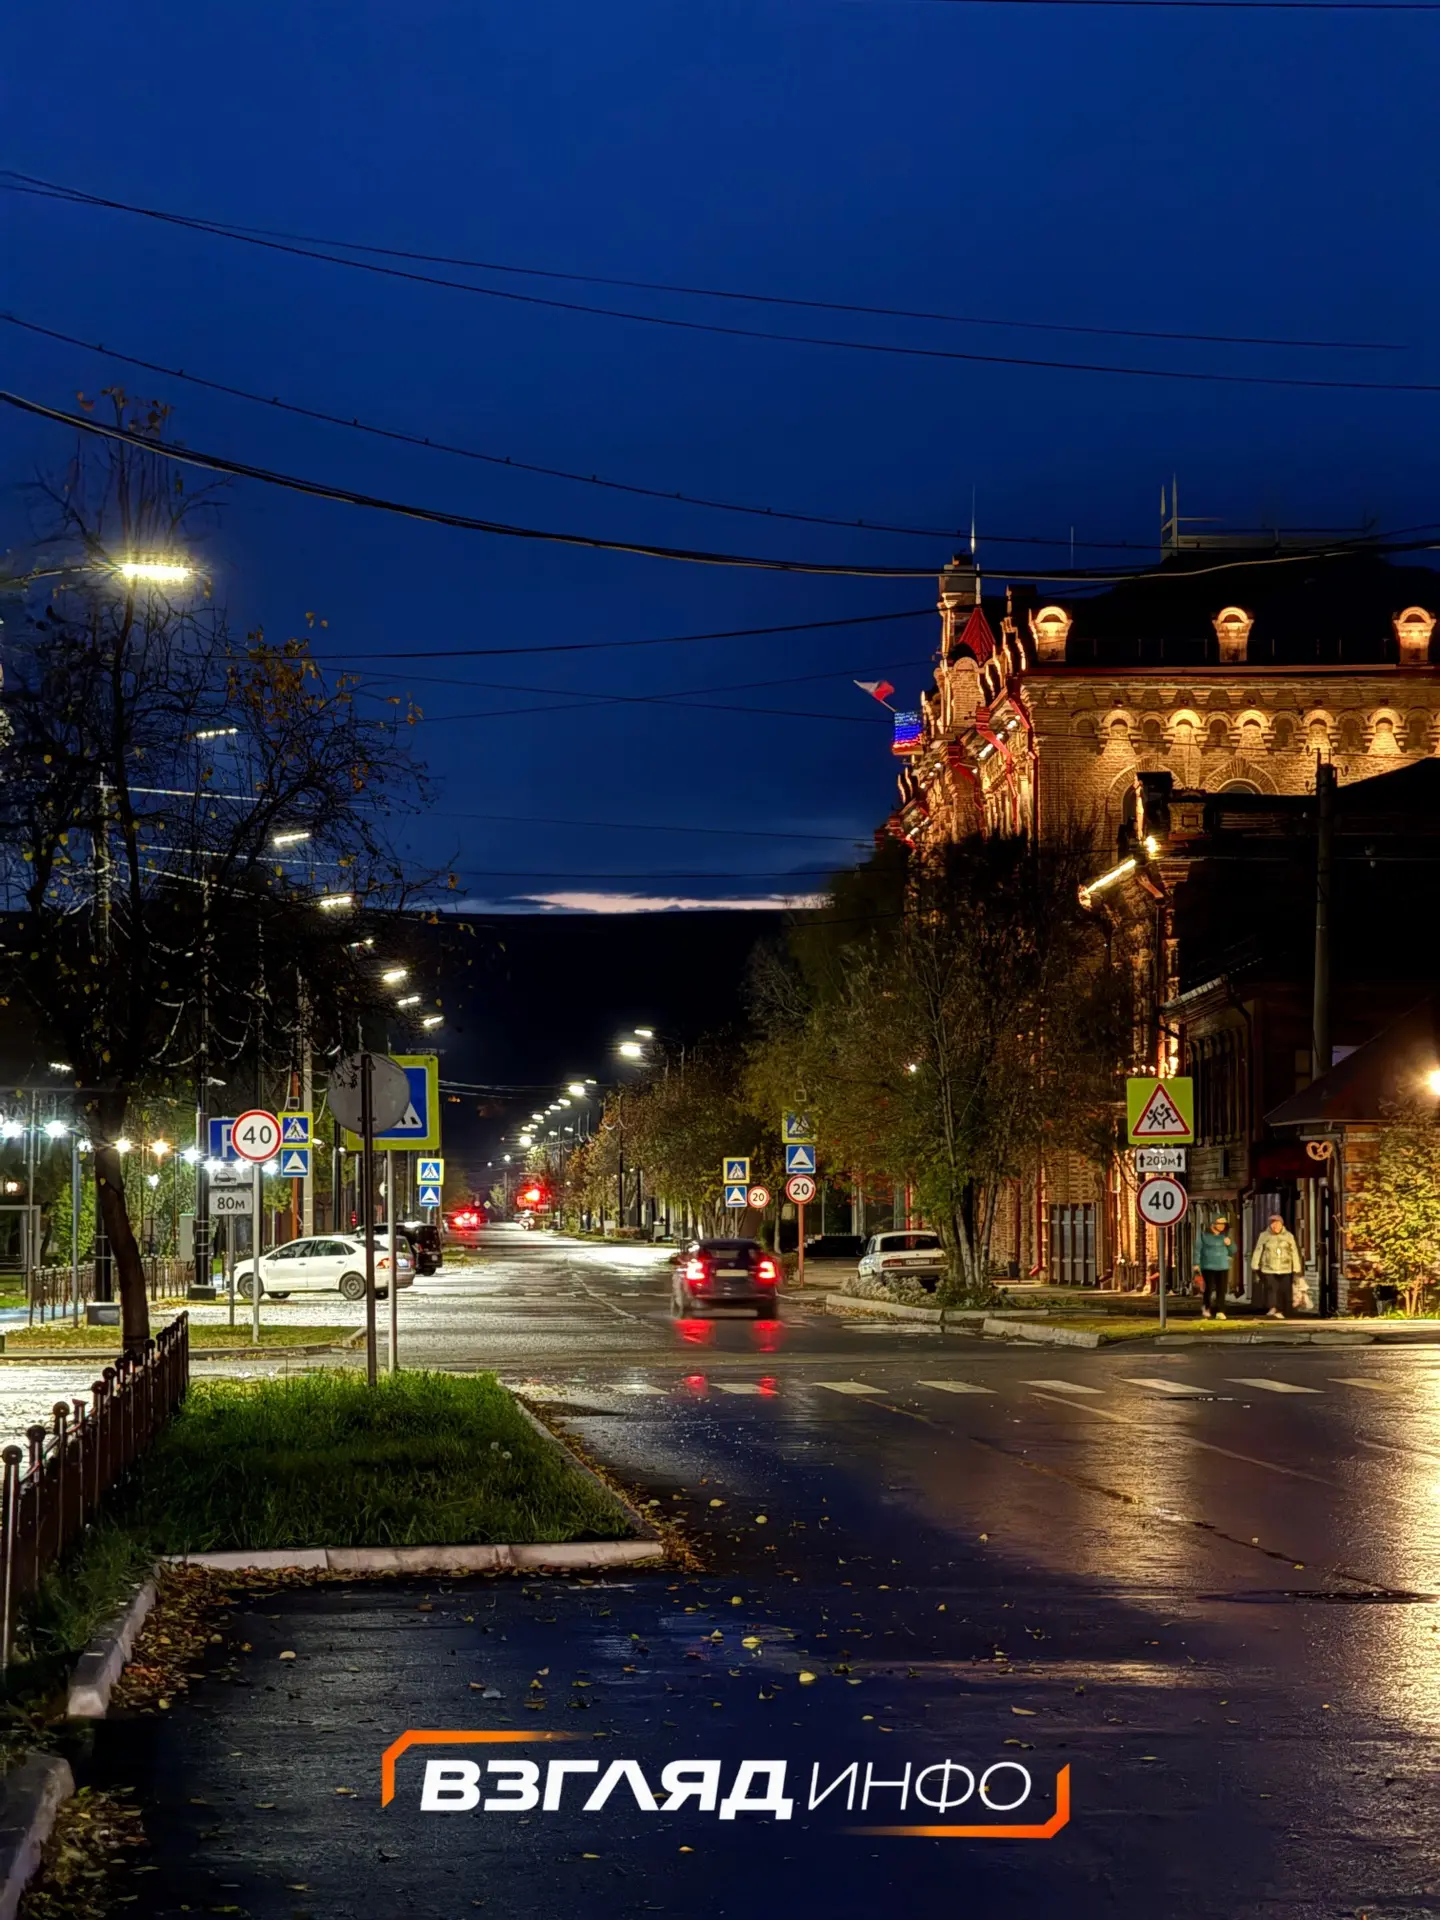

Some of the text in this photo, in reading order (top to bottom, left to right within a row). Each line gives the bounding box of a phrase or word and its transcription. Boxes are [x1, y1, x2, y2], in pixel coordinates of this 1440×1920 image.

[242, 1126, 272, 1144] 40
[1146, 1156, 1176, 1166] 200м
[792, 1183, 809, 1196] 20
[217, 1196, 246, 1210] 80м
[752, 1192, 765, 1202] 20
[1148, 1191, 1174, 1210] 40
